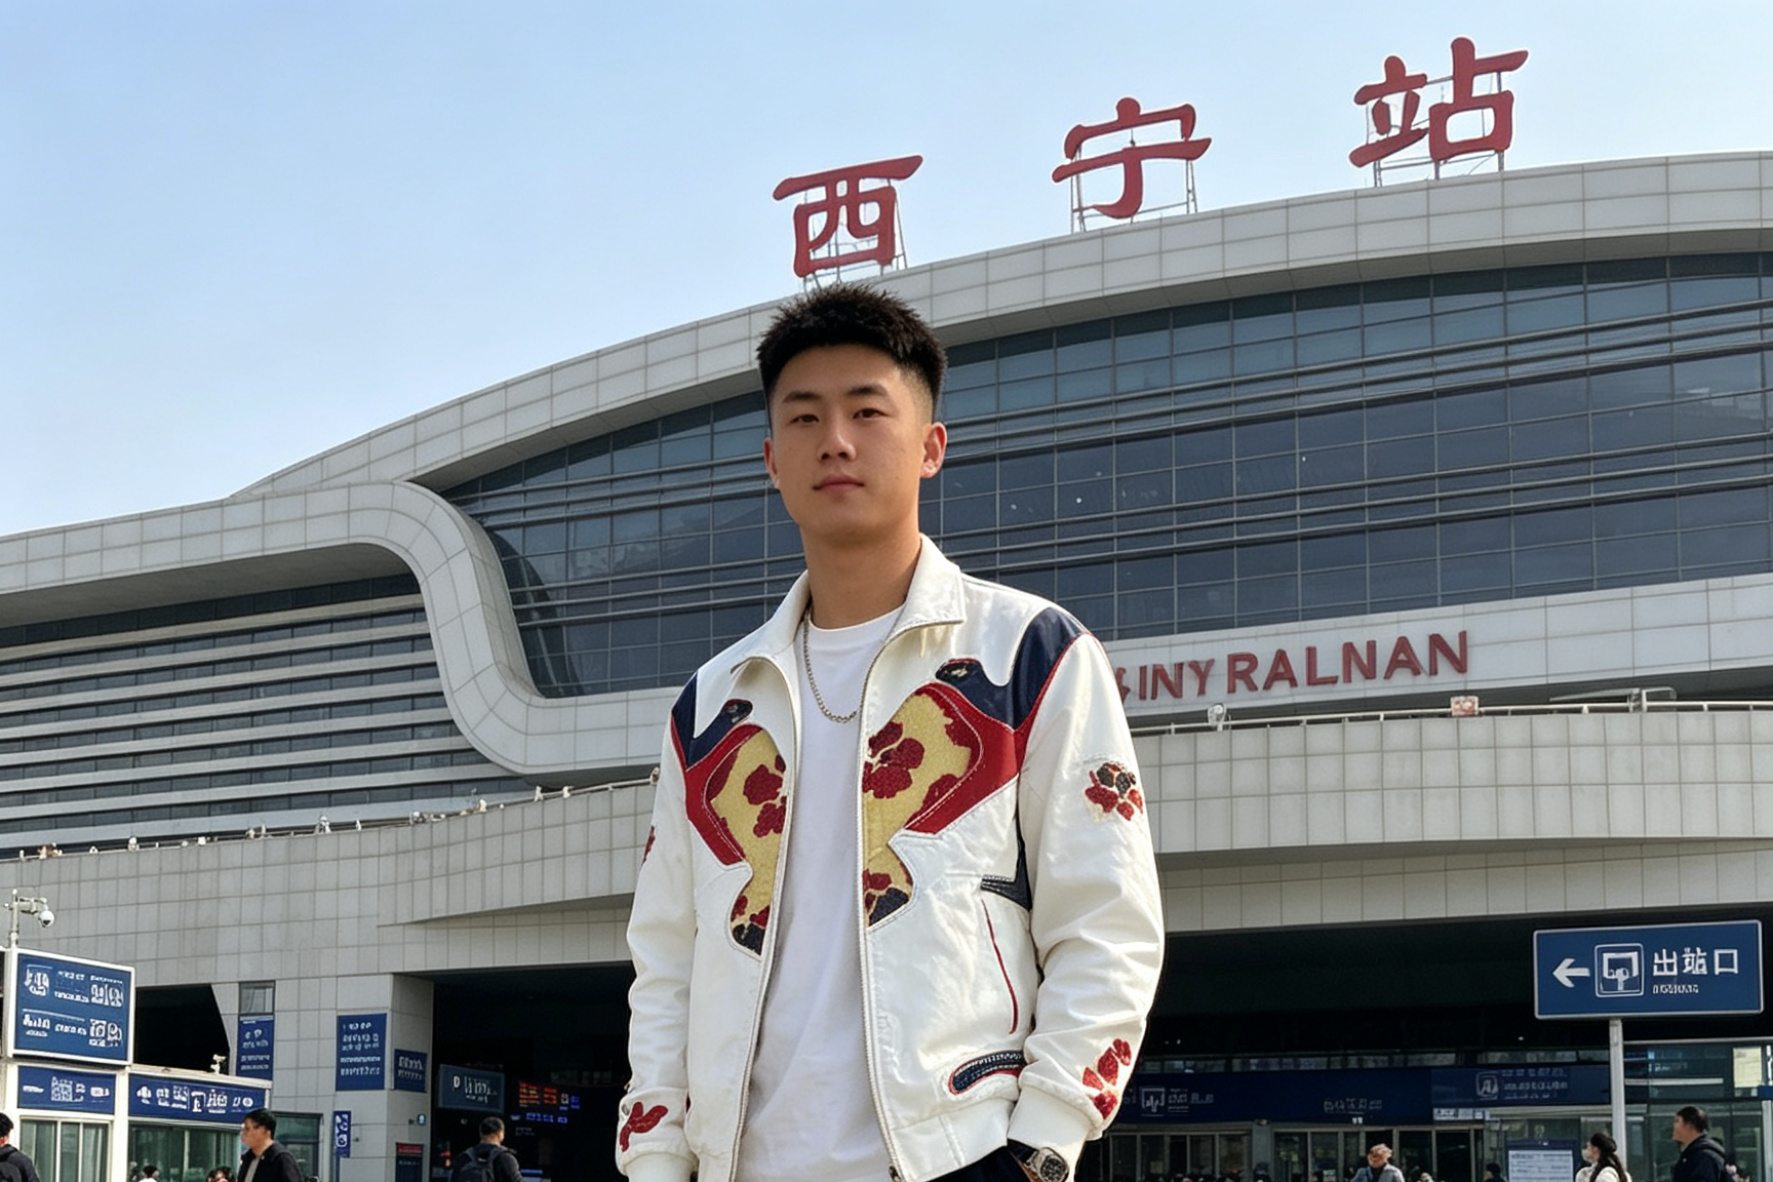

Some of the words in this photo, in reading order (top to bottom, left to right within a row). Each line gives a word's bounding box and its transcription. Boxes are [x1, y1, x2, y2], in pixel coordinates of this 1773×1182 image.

[773, 36, 1529, 278] 西宁站
[1227, 630, 1468, 694] RALNAN
